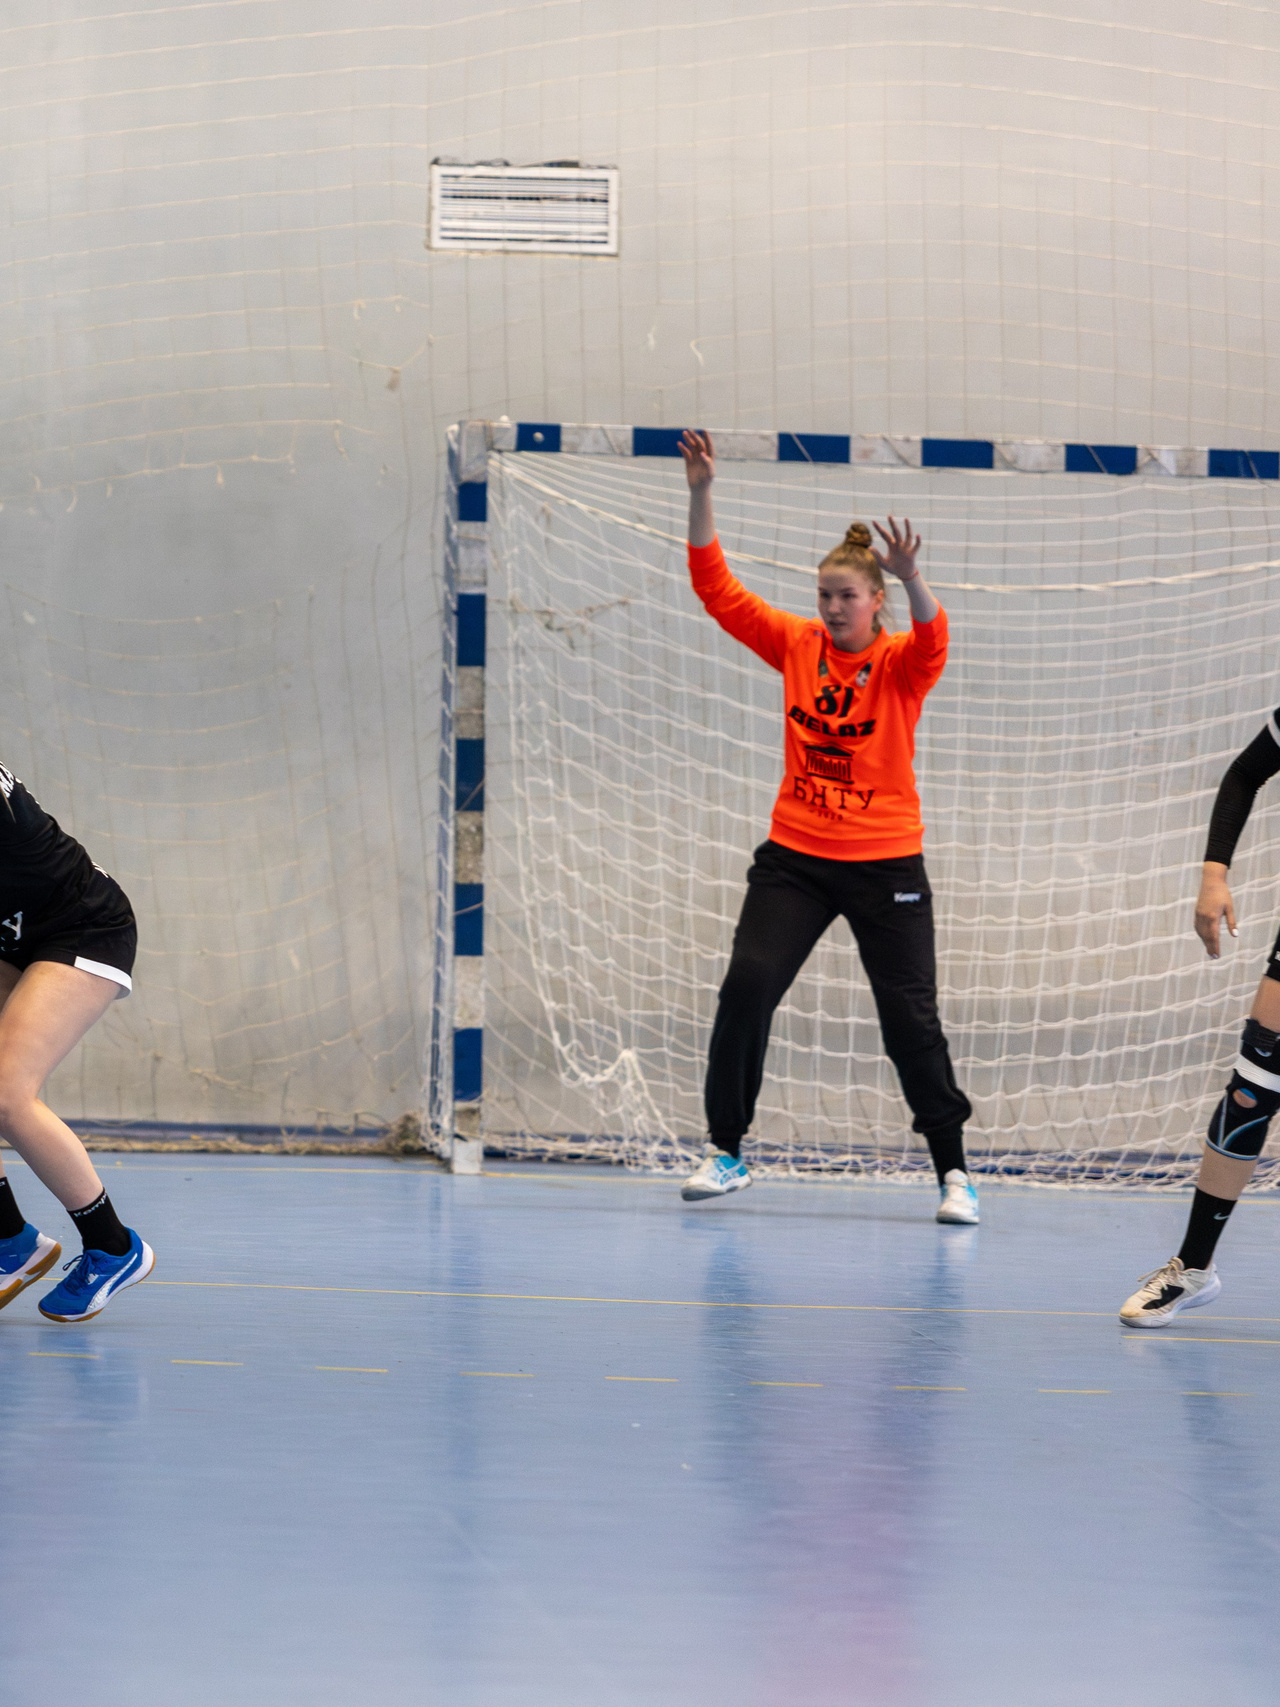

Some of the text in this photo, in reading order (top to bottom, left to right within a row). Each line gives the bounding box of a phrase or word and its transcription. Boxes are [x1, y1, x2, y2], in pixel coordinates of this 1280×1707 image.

[815, 684, 854, 718] 81
[787, 705, 877, 737] BELAZ
[794, 776, 875, 810] БНТУ
